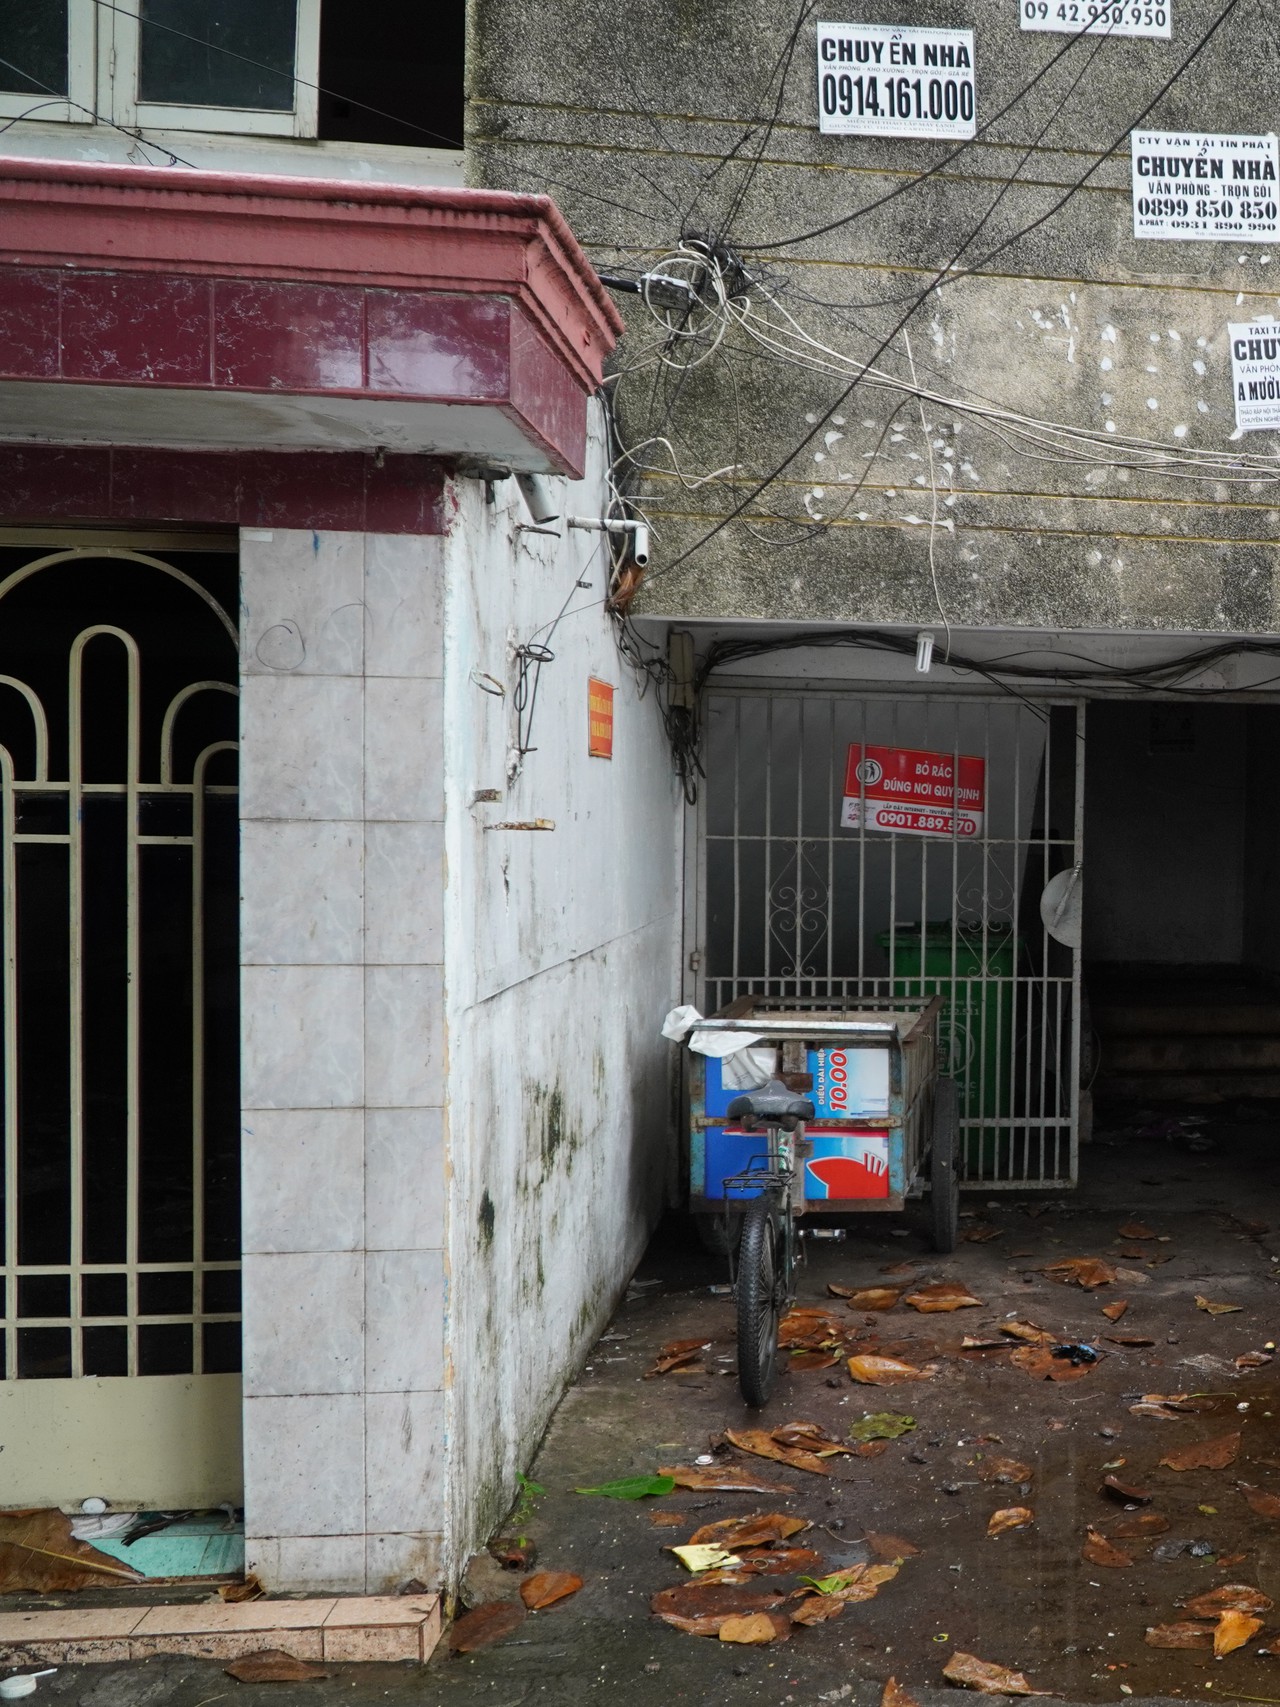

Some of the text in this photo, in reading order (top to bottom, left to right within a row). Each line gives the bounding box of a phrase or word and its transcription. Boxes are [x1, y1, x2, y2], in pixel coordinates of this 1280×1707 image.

[821, 34, 971, 68] CHUYỂN NHÀ
[822, 73, 974, 121] 0914.161.000
[1138, 136, 1161, 145] CTY
[1166, 137, 1191, 148] VẬN
[1219, 138, 1238, 148] TÍN
[1242, 139, 1272, 149] PHÁT
[1137, 147, 1277, 181] CHUYỂN NHÀ
[1148, 180, 1271, 200] VĂN PHÒNG TRỌN GÓI
[1137, 197, 1277, 220] 0899 850 850
[1171, 220, 1208, 230] 0931
[1214, 221, 1243, 231] 890
[1248, 222, 1276, 231] 990
[1248, 326, 1270, 336] TAXI
[1240, 363, 1258, 374] VĂN
[1238, 382, 1246, 401] A
[915, 760, 952, 777] BỎ RÁC
[883, 777, 980, 802] ĐÚNG NƠI QUY ĐỊNH
[879, 811, 973, 833] 0901.889.570
[829, 1048, 848, 1111] 10.00
